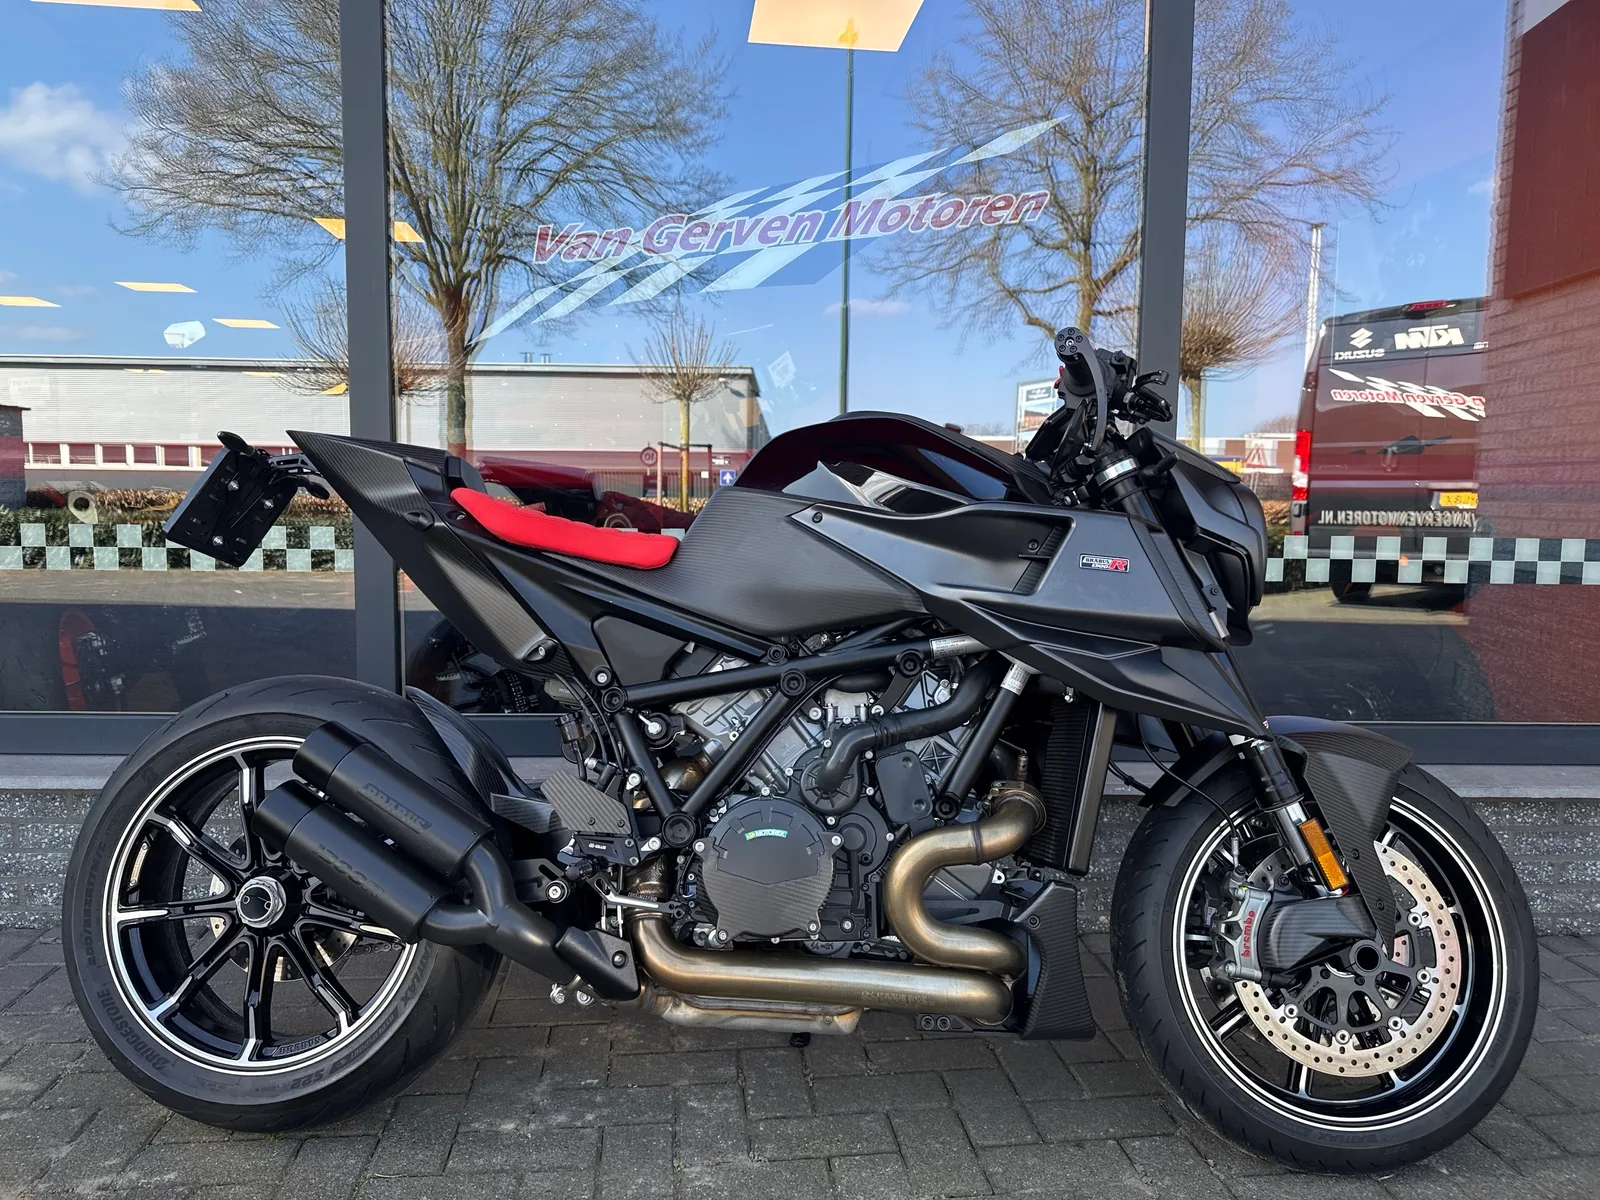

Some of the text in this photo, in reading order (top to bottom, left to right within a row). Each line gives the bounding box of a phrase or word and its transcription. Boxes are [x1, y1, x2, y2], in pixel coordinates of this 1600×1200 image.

[533, 189, 1051, 265] Van Gerven Motoren
[1085, 556, 1110, 565] BRABUS
[361, 783, 428, 831] BRABUS
[756, 828, 784, 837] MOTOREX
[1241, 910, 1256, 958] brembo
[401, 941, 433, 1008] ATTLAX
[97, 988, 169, 1071] BRIDGESTONE
[279, 1035, 322, 1055] BRABUS
[290, 1067, 325, 1089] S22
